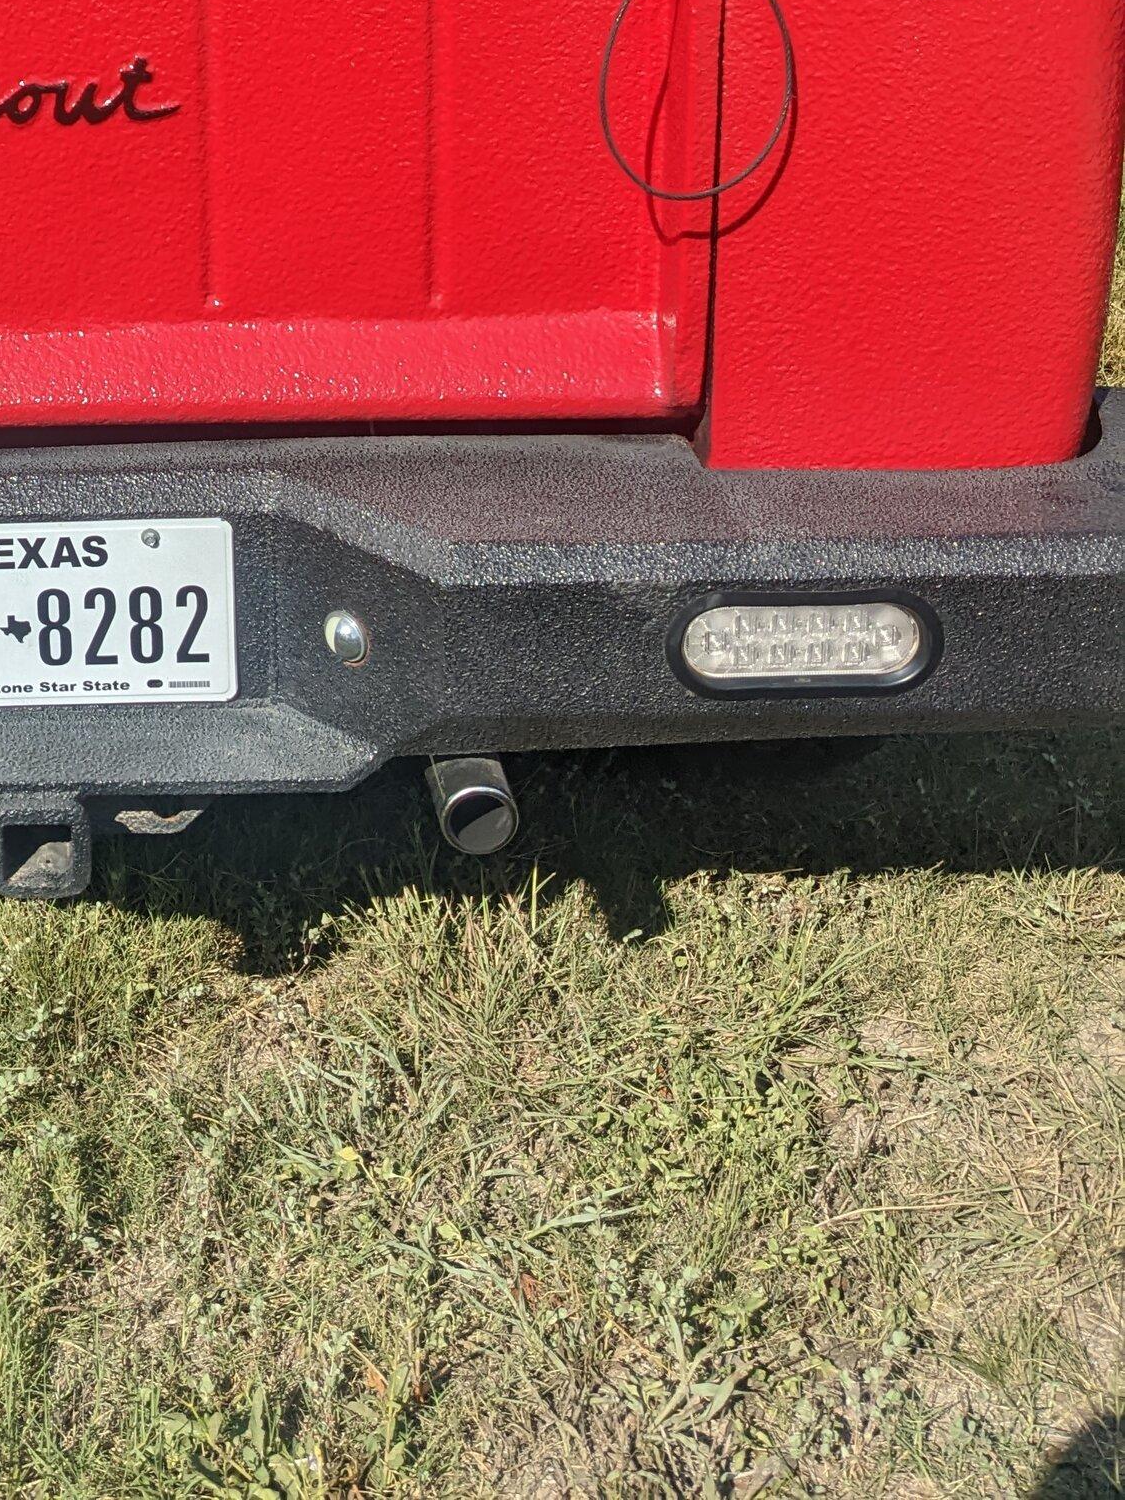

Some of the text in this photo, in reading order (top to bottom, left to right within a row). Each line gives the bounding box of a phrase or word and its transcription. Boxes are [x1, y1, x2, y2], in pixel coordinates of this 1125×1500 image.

[36, 585, 211, 666] 8282
[39, 681, 77, 692] Star
[82, 679, 131, 692] State
